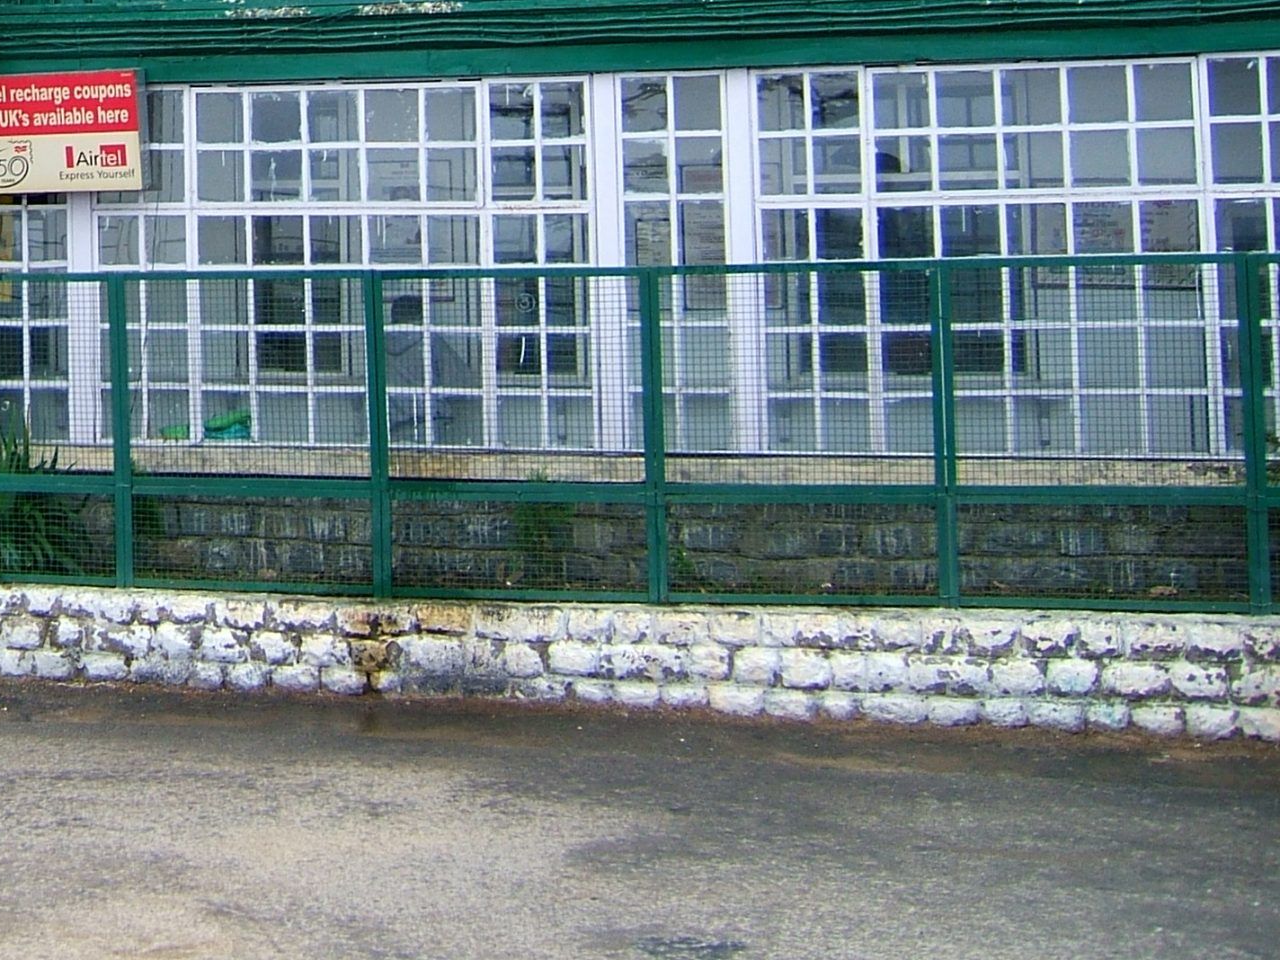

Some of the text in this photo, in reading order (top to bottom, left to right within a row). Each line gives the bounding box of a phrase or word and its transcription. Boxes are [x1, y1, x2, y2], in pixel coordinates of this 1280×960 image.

[10, 83, 70, 105] recharge
[73, 82, 132, 102] coupons
[33, 107, 94, 127] available
[98, 105, 129, 124] here
[76, 149, 123, 167] Airtel
[59, 168, 136, 182] Express Yourself
